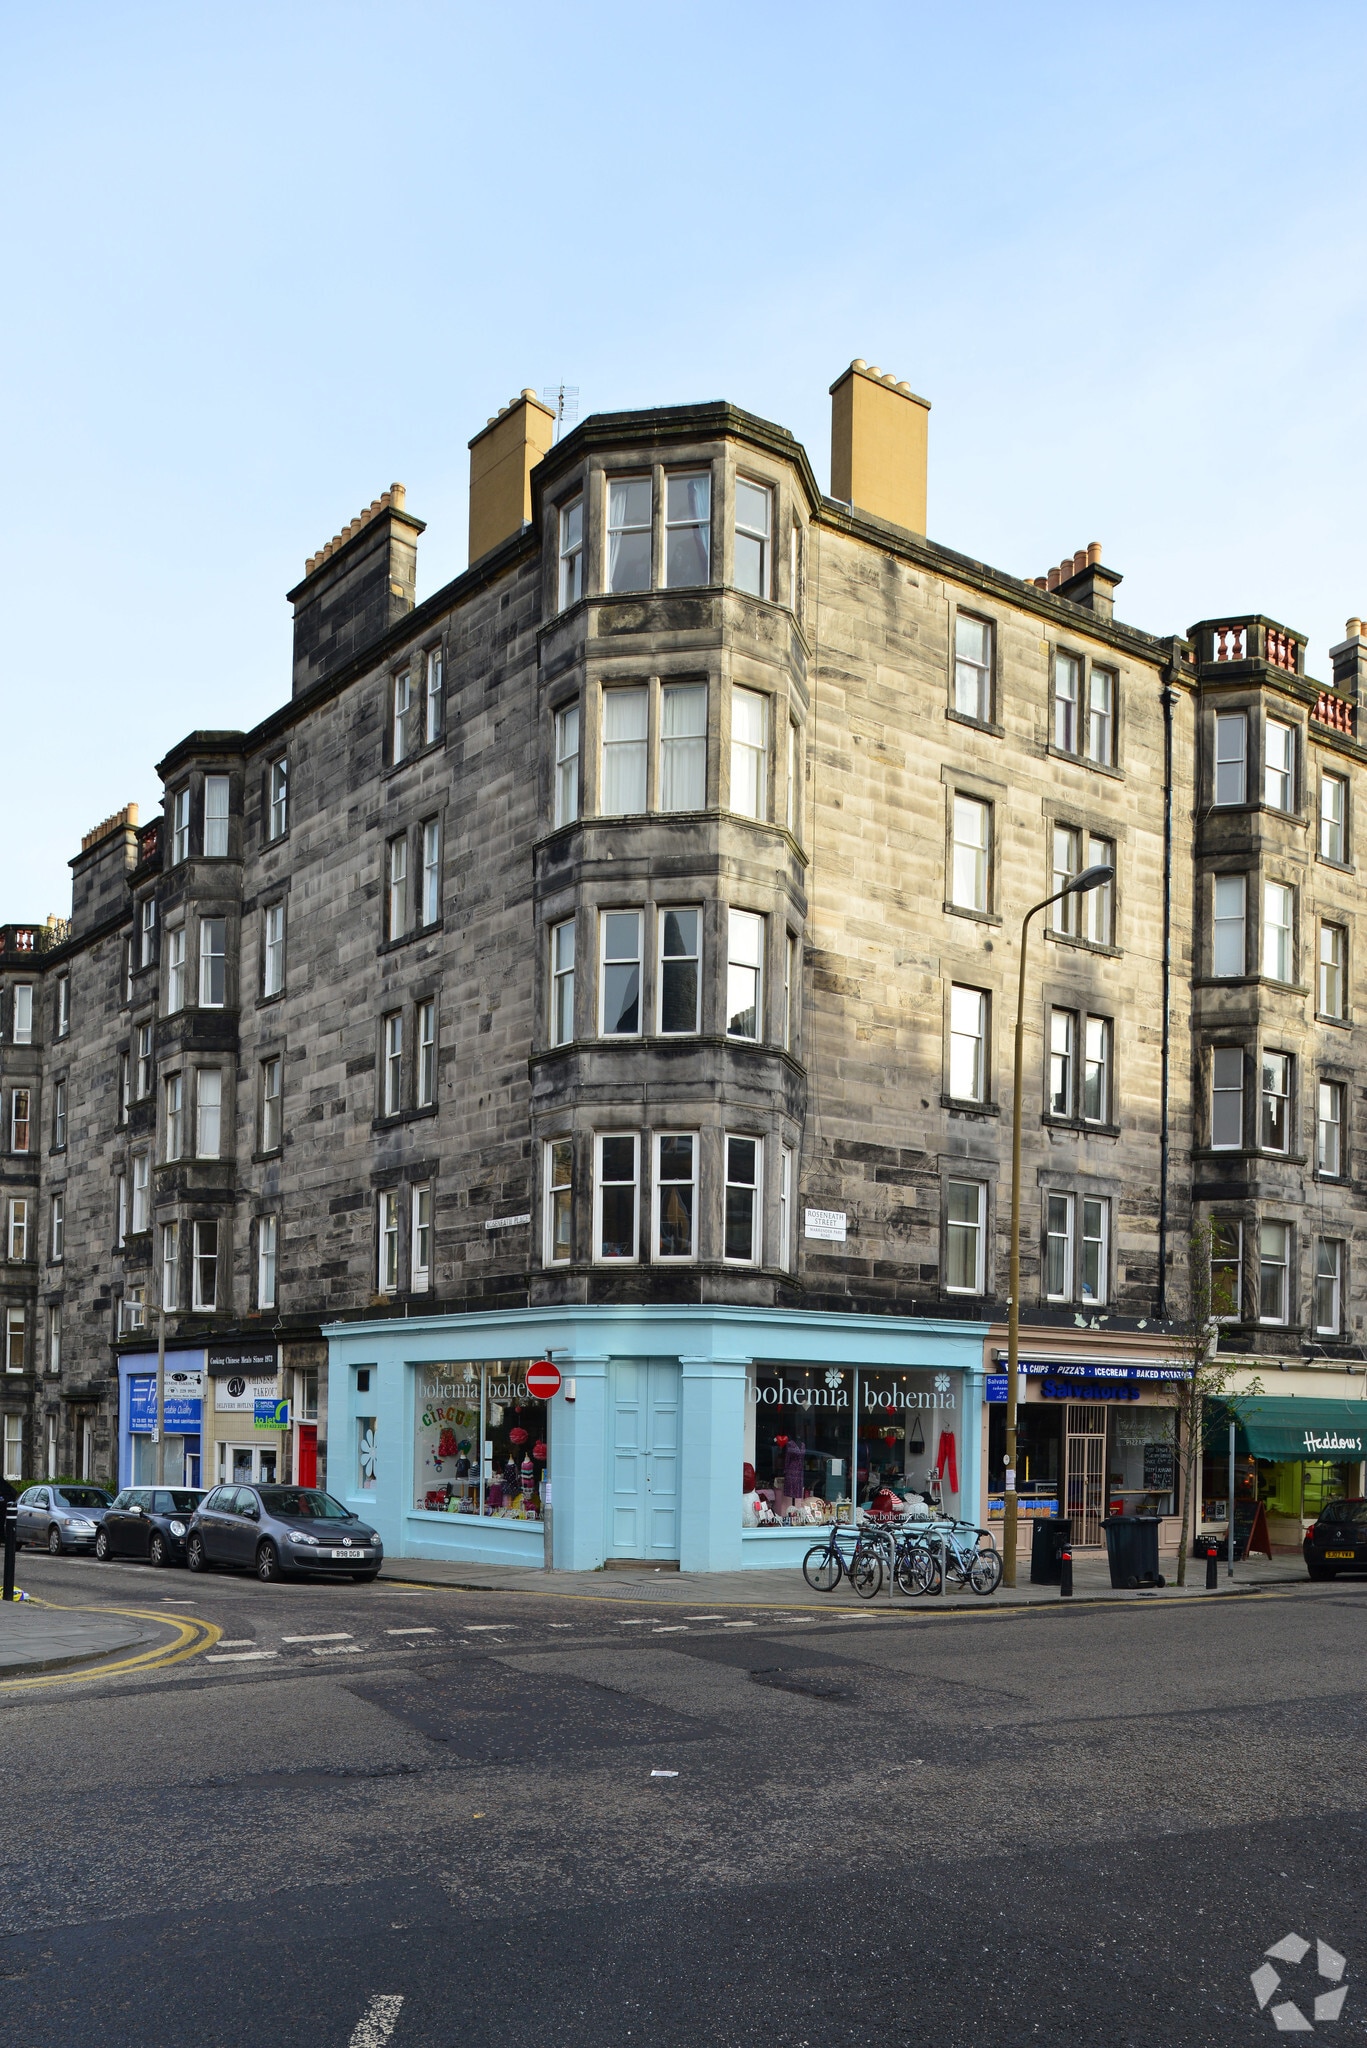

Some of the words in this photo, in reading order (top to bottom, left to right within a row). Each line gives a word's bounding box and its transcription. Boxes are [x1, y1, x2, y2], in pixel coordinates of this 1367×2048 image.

[808, 1210, 844, 1220] ROSENEATH
[814, 1218, 837, 1226] STREET
[210, 1356, 224, 1366] Cooking
[226, 1356, 240, 1364] Chinese
[1023, 1364, 1028, 1373] &
[1029, 1364, 1050, 1374] CHIPS
[1057, 1366, 1085, 1375] PIZZA'S
[1094, 1367, 1128, 1377] ICECREAM
[1136, 1369, 1158, 1378] BAKED
[420, 1376, 479, 1398] bohemia
[488, 1375, 534, 1398] bohe
[748, 1377, 849, 1407] bohemia
[1042, 1378, 1140, 1400] Salvatore's
[864, 1382, 956, 1409] bohemia
[177, 1406, 192, 1416] Quality
[265, 1415, 276, 1424] let
[1304, 1432, 1362, 1452] Haddows
